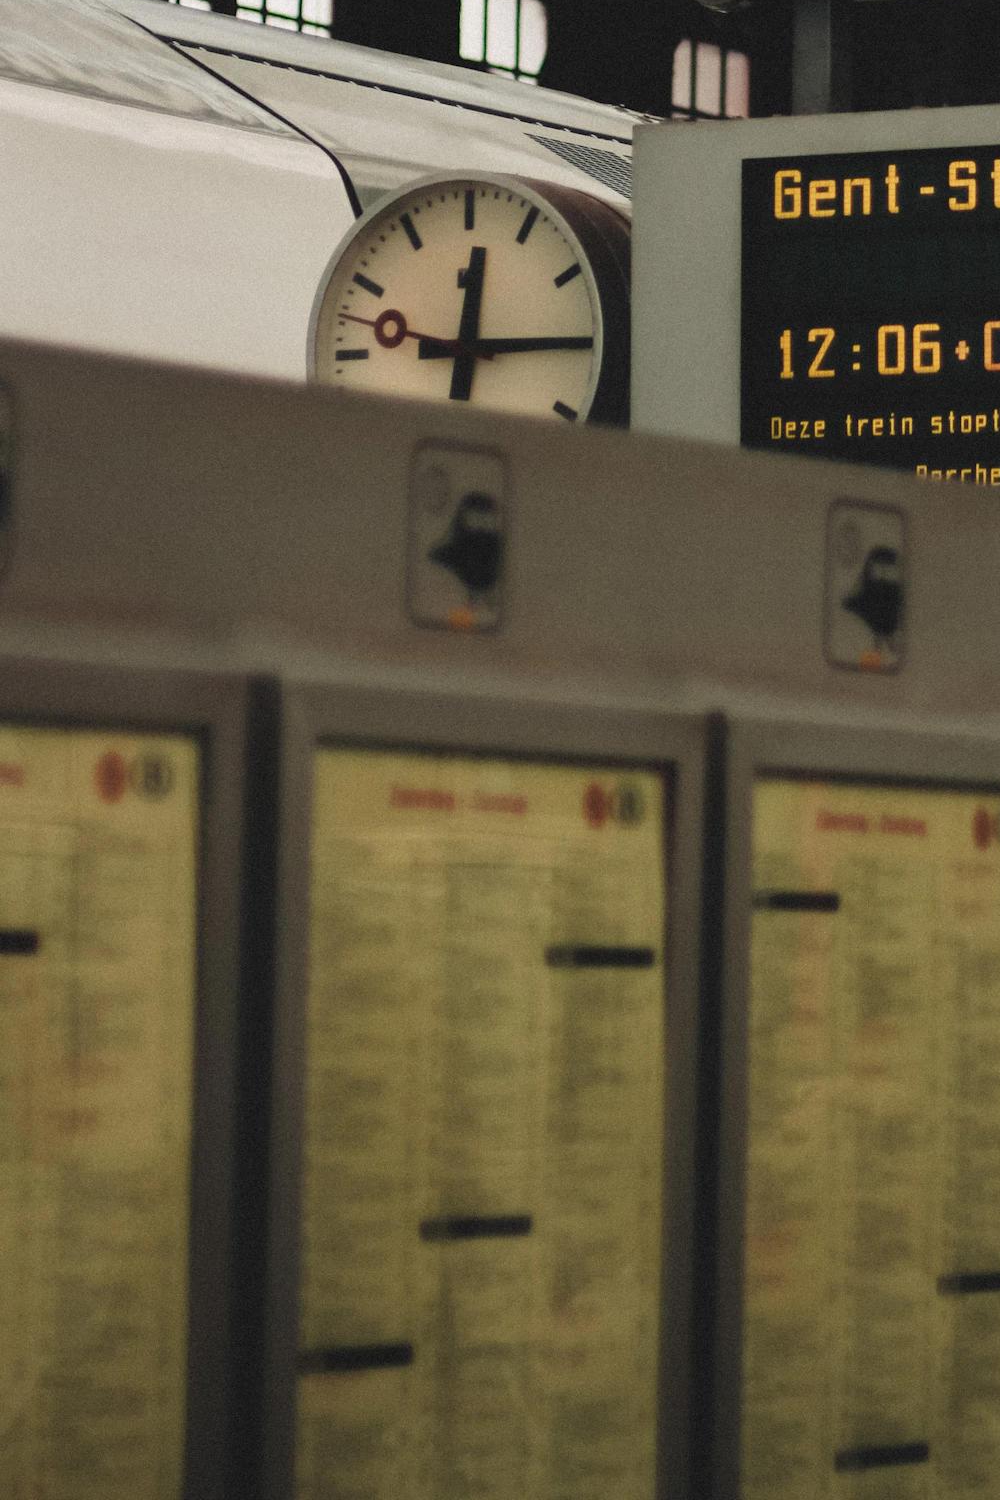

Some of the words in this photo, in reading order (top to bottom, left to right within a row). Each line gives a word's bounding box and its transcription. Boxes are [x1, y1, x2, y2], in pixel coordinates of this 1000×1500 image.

[771, 416, 826, 439] Deze
[846, 413, 913, 437] trein
[930, 409, 999, 434] stopt
